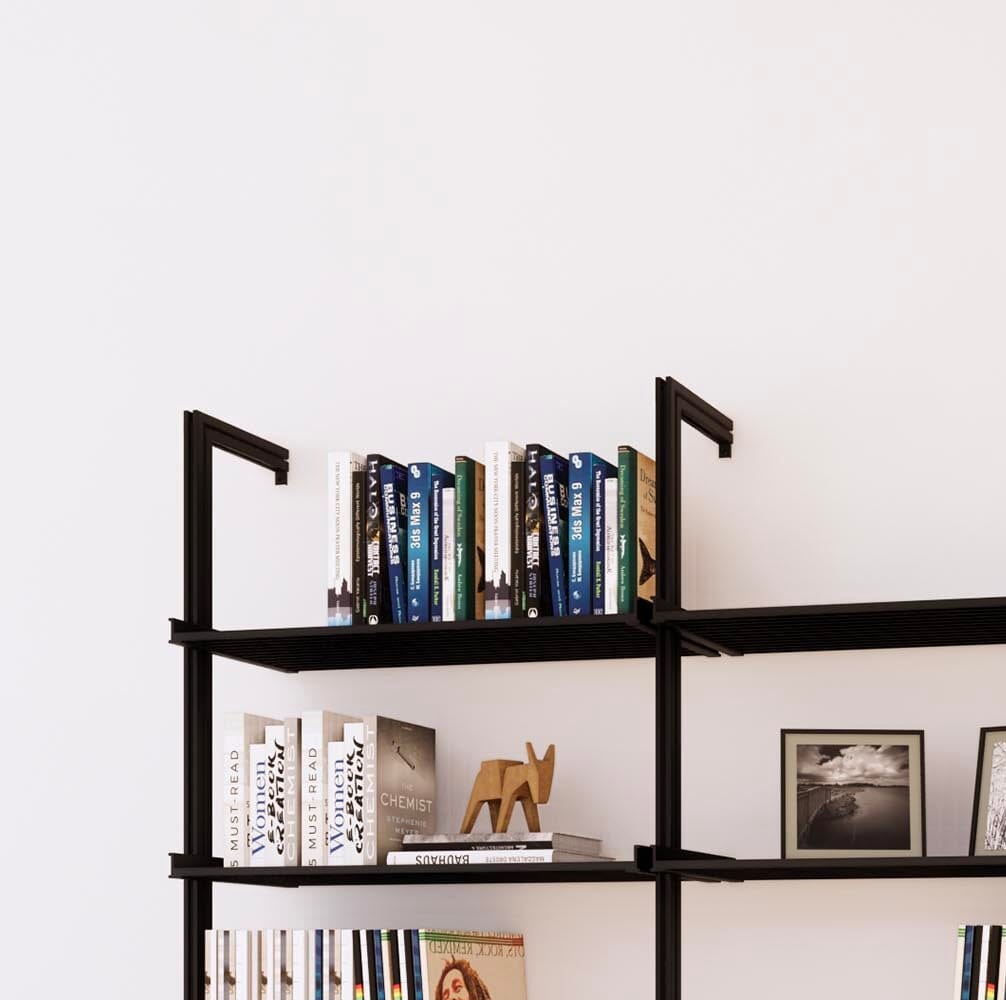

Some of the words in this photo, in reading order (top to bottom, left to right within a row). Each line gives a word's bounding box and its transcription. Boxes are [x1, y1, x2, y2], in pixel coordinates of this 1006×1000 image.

[368, 460, 378, 519] HALO
[410, 502, 421, 525] Max
[528, 450, 538, 510] HALO
[547, 473, 560, 557] BUSINESS
[571, 482, 582, 490] 9
[571, 492, 582, 517] Max
[386, 483, 400, 565] BUSINESS
[410, 528, 421, 549] 3ds
[571, 520, 582, 540] 3ds
[230, 750, 239, 850] MUST-READ
[252, 762, 266, 856] Women
[268, 751, 276, 843] E-BOOK
[275, 739, 285, 855] CREATION
[308, 747, 317, 849] MUST-READ
[330, 759, 344, 854] Women
[346, 748, 355, 842] E-BOOK
[353, 736, 364, 853] CREATION
[367, 725, 375, 859] CHEMIST
[380, 792, 432, 813] CHEMIST
[416, 855, 469, 865] BAUHAUS
